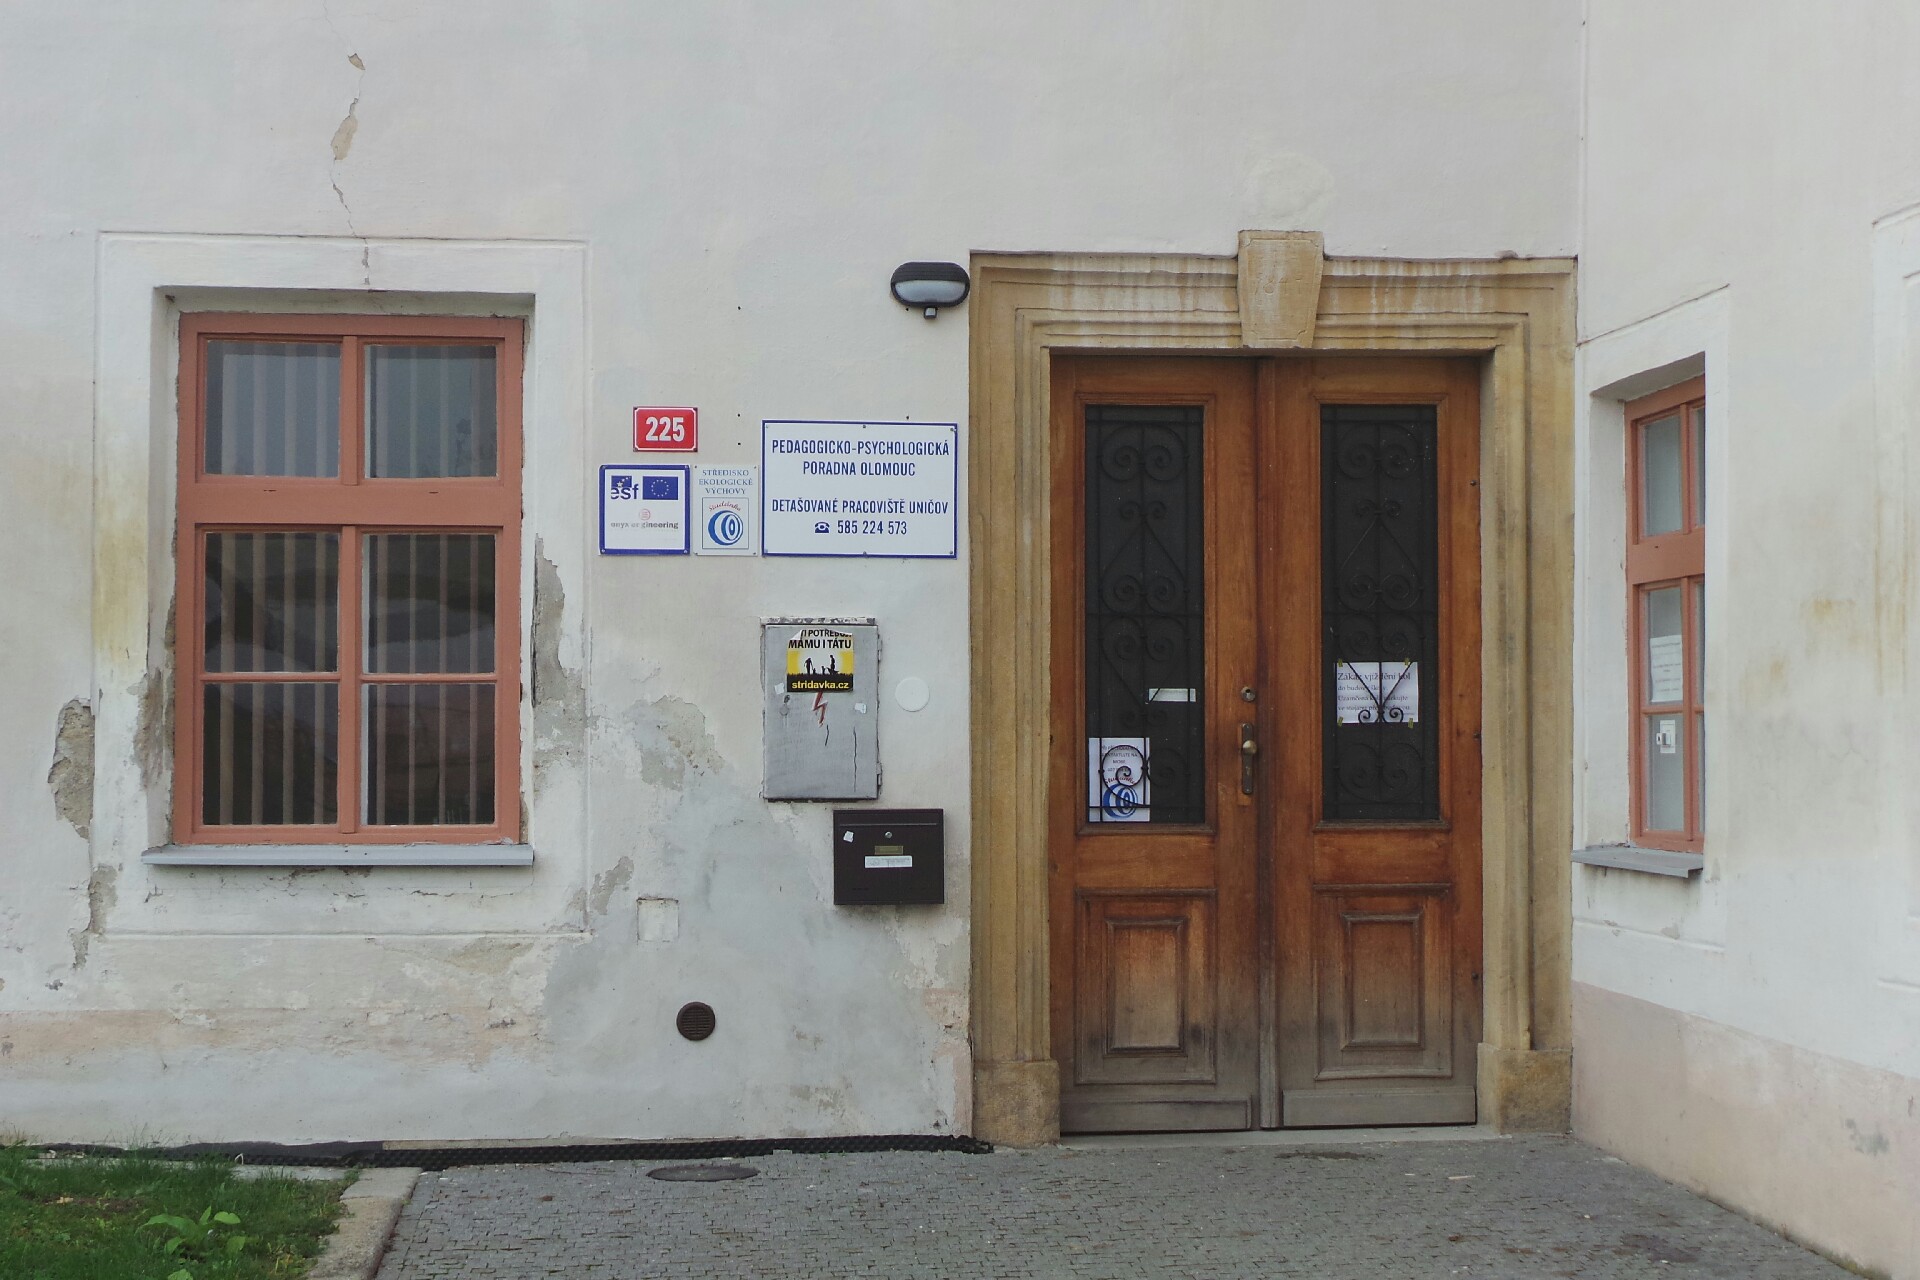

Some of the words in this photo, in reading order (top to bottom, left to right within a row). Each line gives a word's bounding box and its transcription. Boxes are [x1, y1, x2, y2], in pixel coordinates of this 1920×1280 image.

[645, 416, 685, 442] 225
[772, 438, 950, 456] PEDAGOGICKO-PSYCHOLOGICKÁ
[702, 468, 749, 476] STŘEDISKO
[803, 461, 856, 475] PORADNA
[860, 462, 916, 476] OLOMOUC
[699, 477, 753, 486] EKOLOGICKÉ
[610, 483, 639, 500] esf
[705, 487, 746, 495] VÝCHOVY
[772, 498, 839, 514] DETAŠOVANÉ
[842, 498, 906, 514] PRACOVIŠTĚ
[908, 500, 949, 515] UNIČOV
[837, 520, 859, 535] 585
[862, 520, 883, 535] 224
[888, 520, 908, 535] 573
[823, 640, 826, 648] I
[827, 638, 851, 648] TÁTU
[791, 680, 850, 689] stridavka.cz
